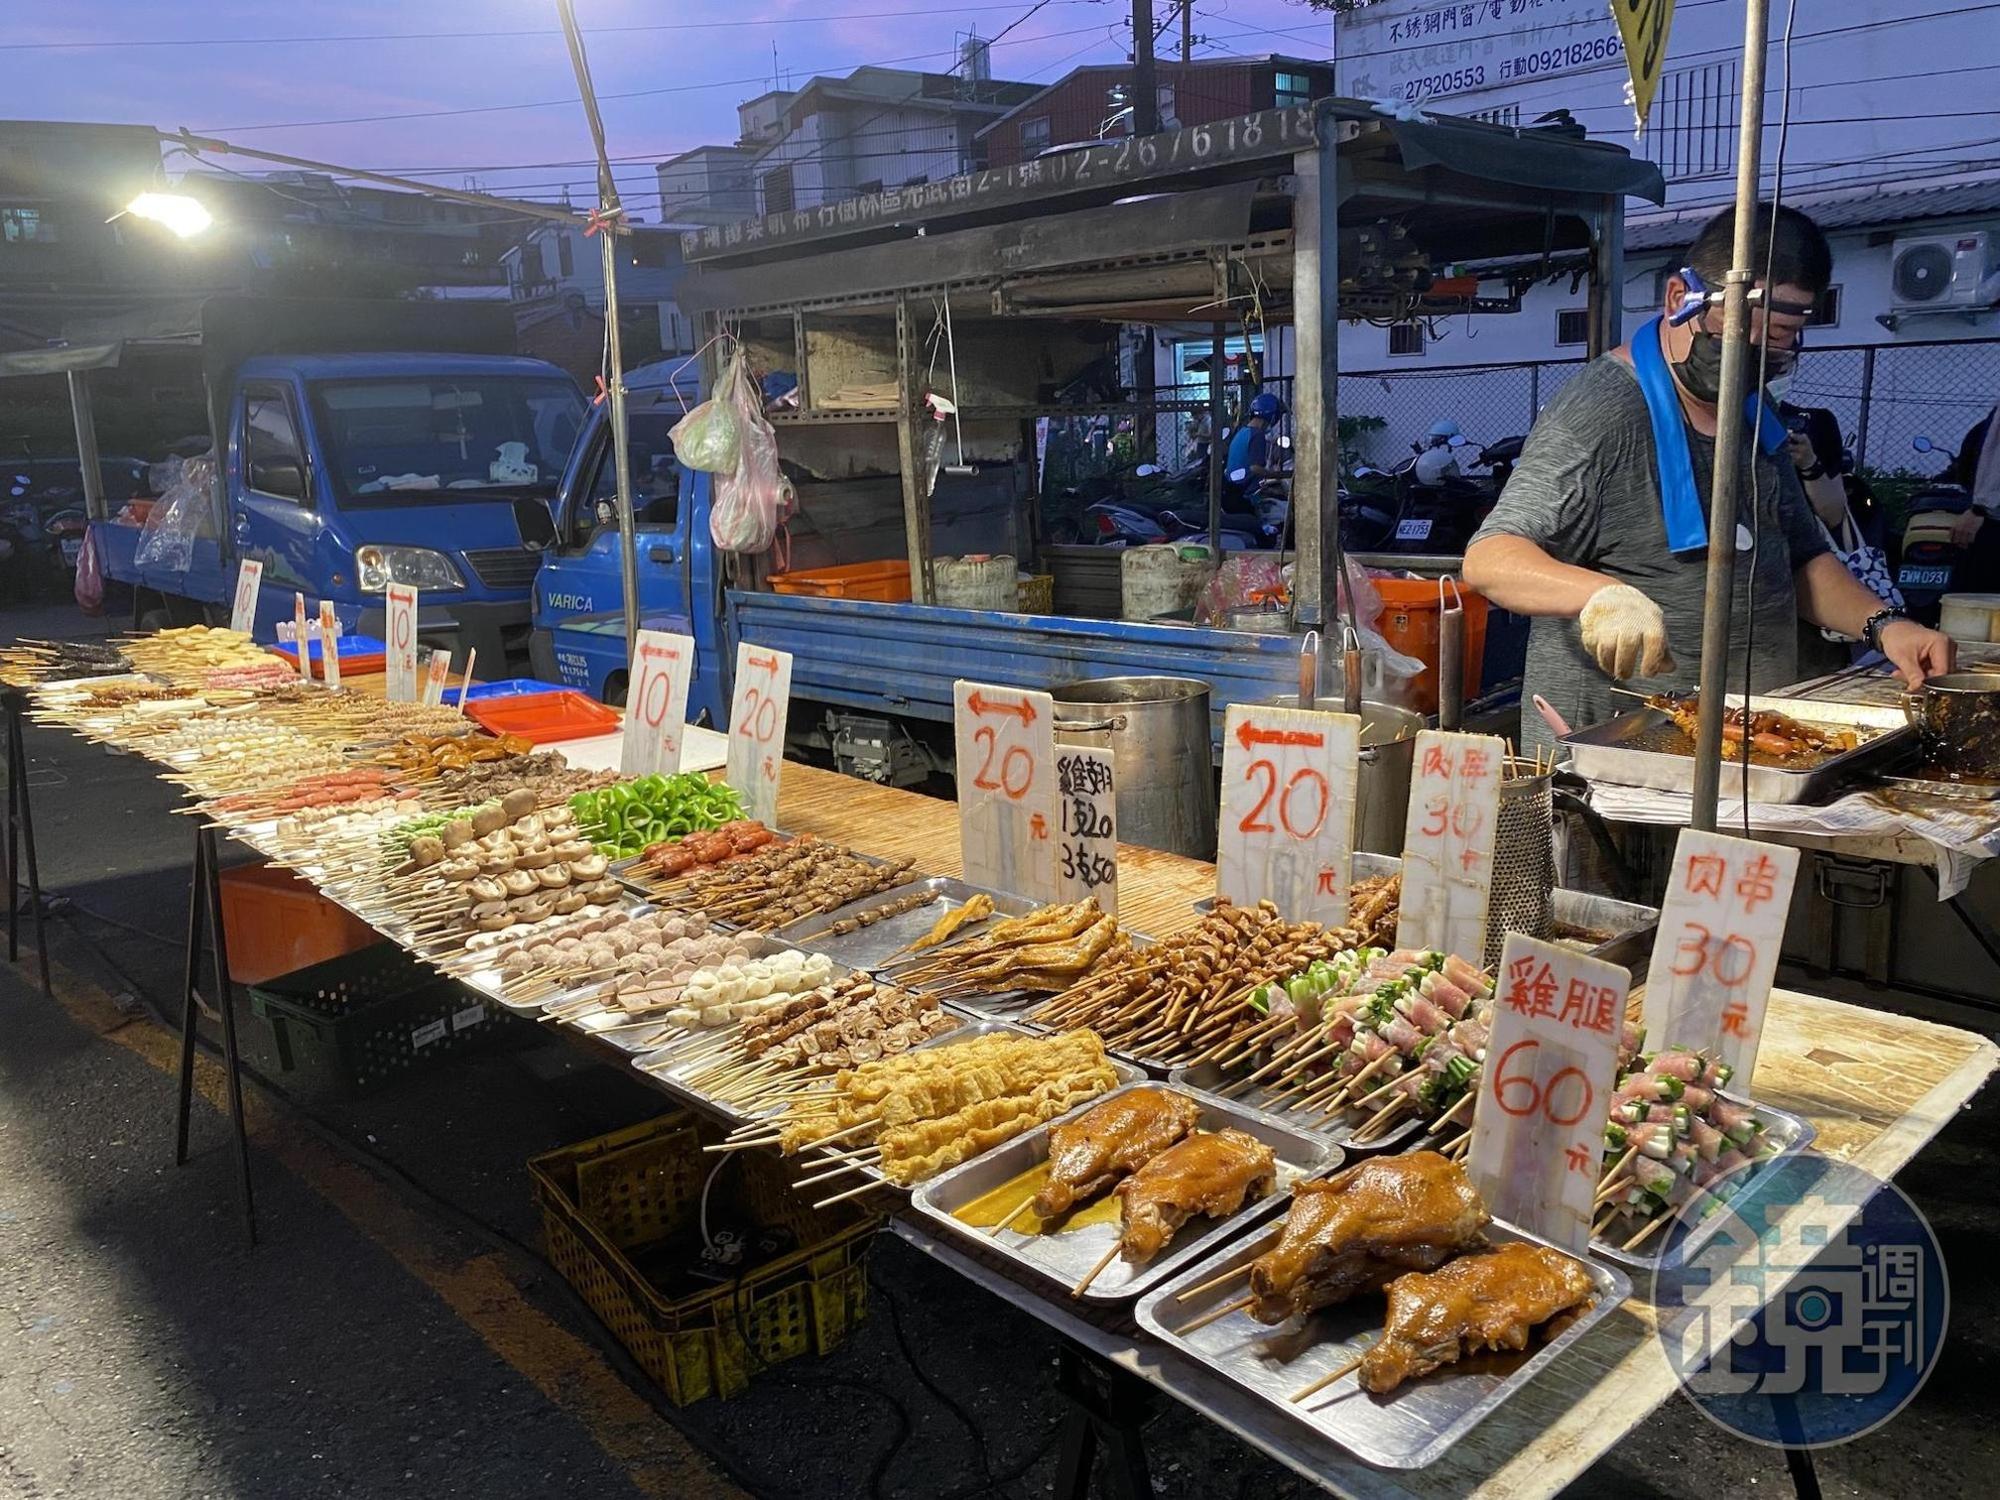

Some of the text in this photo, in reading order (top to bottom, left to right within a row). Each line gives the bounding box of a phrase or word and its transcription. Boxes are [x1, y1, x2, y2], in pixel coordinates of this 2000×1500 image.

[1405, 65, 1485, 101] 27820553
[548, 592, 593, 612] VARICA
[391, 606, 410, 651] 10
[635, 663, 670, 728] 10
[739, 687, 777, 742] 20
[973, 726, 1034, 799] 20
[1421, 745, 1489, 789] 肉串
[1238, 759, 1329, 841] 20
[1421, 794, 1483, 839] 30
[1030, 813, 1048, 840] 元
[1317, 866, 1336, 896] 元
[1685, 851, 1780, 914] 肉串
[1670, 921, 1757, 987] 30
[1504, 955, 1619, 1035] 雞腿
[1721, 1003, 1752, 1039] 元
[1493, 1039, 1593, 1126] 60
[1564, 1142, 1592, 1177] 元
